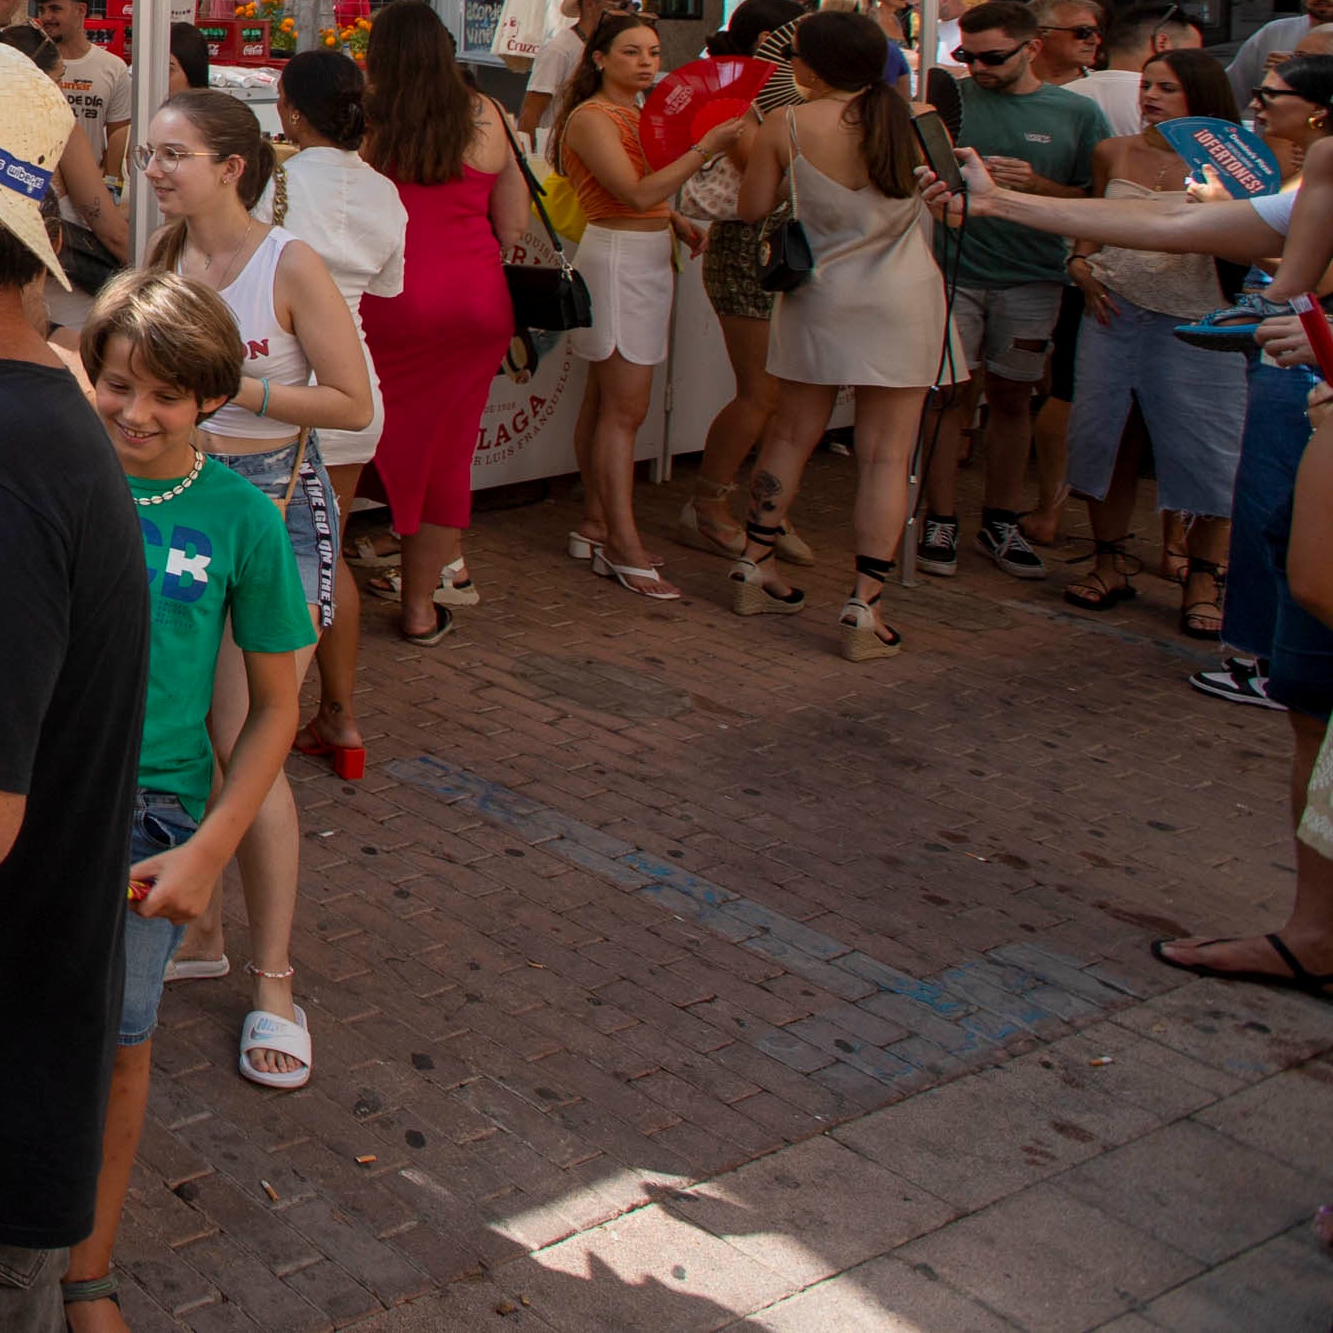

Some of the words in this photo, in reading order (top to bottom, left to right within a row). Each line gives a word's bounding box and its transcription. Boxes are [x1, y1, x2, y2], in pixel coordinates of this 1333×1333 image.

[67, 94, 83, 105] DE
[84, 94, 104, 107] DÍA
[81, 108, 98, 119] '23
[1193, 128, 1266, 194] ¡OFERTONES!
